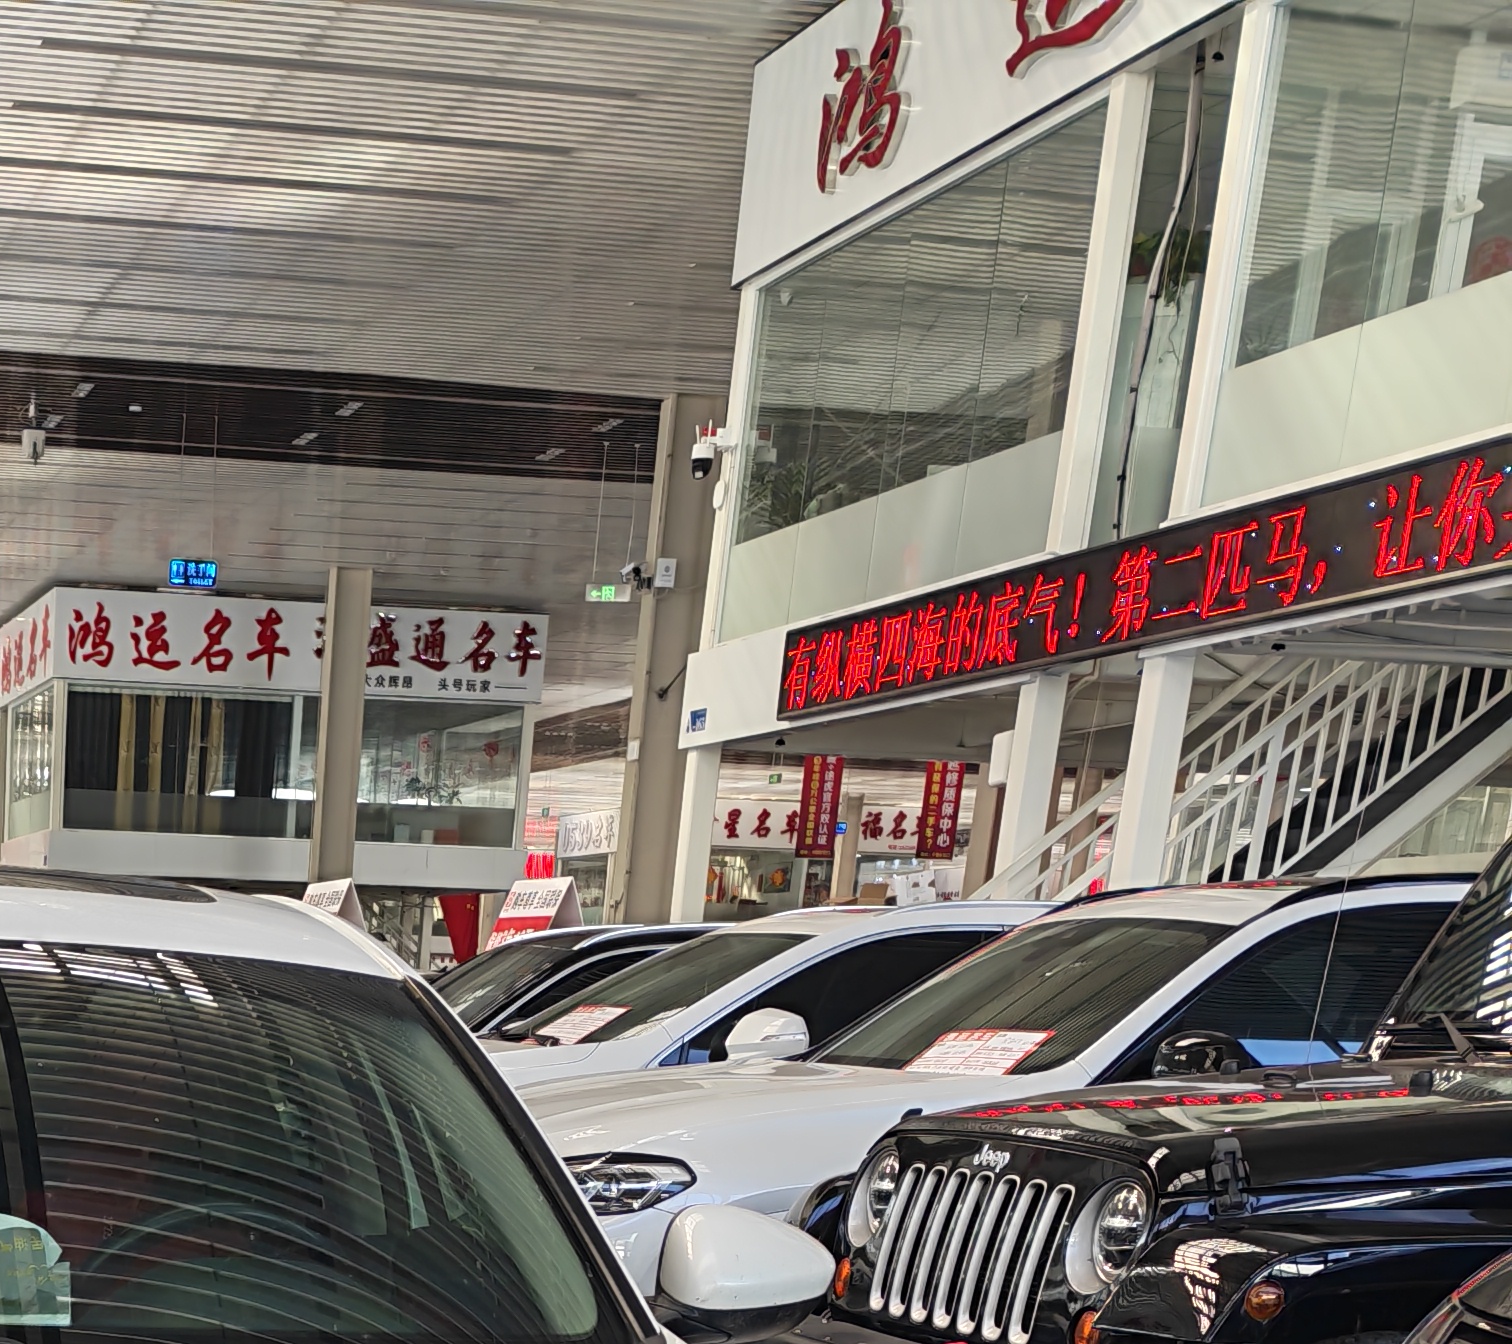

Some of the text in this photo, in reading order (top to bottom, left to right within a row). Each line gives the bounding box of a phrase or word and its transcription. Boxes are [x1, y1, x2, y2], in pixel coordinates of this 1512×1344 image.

[68, 602, 291, 682] 鸿运名车
[438, 677, 491, 692] 头号玩家
[713, 808, 799, 843] 星名车
[973, 1144, 1011, 1173] Jeep
